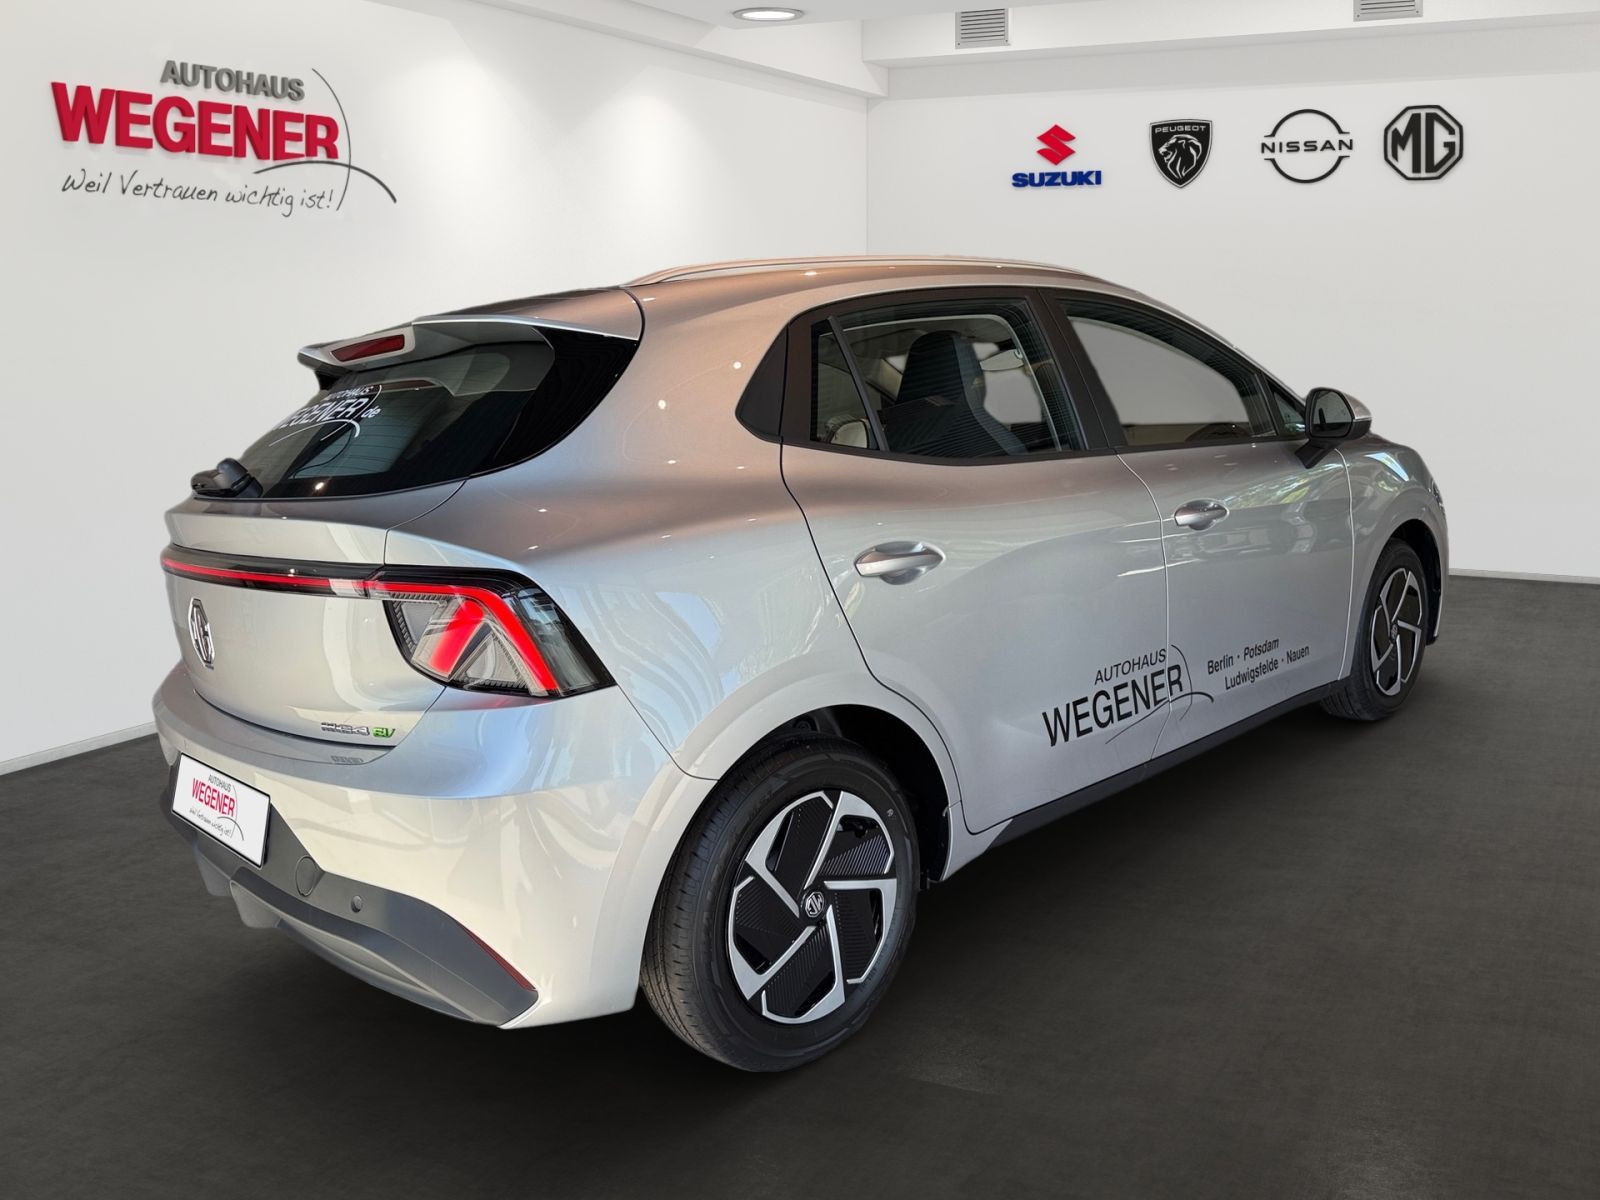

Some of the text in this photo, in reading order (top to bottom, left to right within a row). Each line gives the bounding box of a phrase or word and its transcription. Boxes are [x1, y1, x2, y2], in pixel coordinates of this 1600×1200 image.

[160, 60, 305, 102] AUTOHAUS
[51, 81, 340, 161] WEGENER
[1154, 124, 1207, 133] PEUGEOT
[1261, 139, 1353, 154] NISSAN
[1391, 111, 1456, 174] MG
[61, 168, 334, 217] Weil Vertrauen wichtig ist!
[1012, 170, 1102, 188] SUZUKI
[1094, 648, 1167, 685] AUTOHAUS
[1207, 638, 1280, 675] Berlin Potsdam
[1224, 646, 1310, 690] Ludwigsfelde Nauen
[1042, 664, 1184, 747] WEGENER
[191, 777, 236, 818] WEGENER
[208, 774, 232, 793] AUTOHAUS
